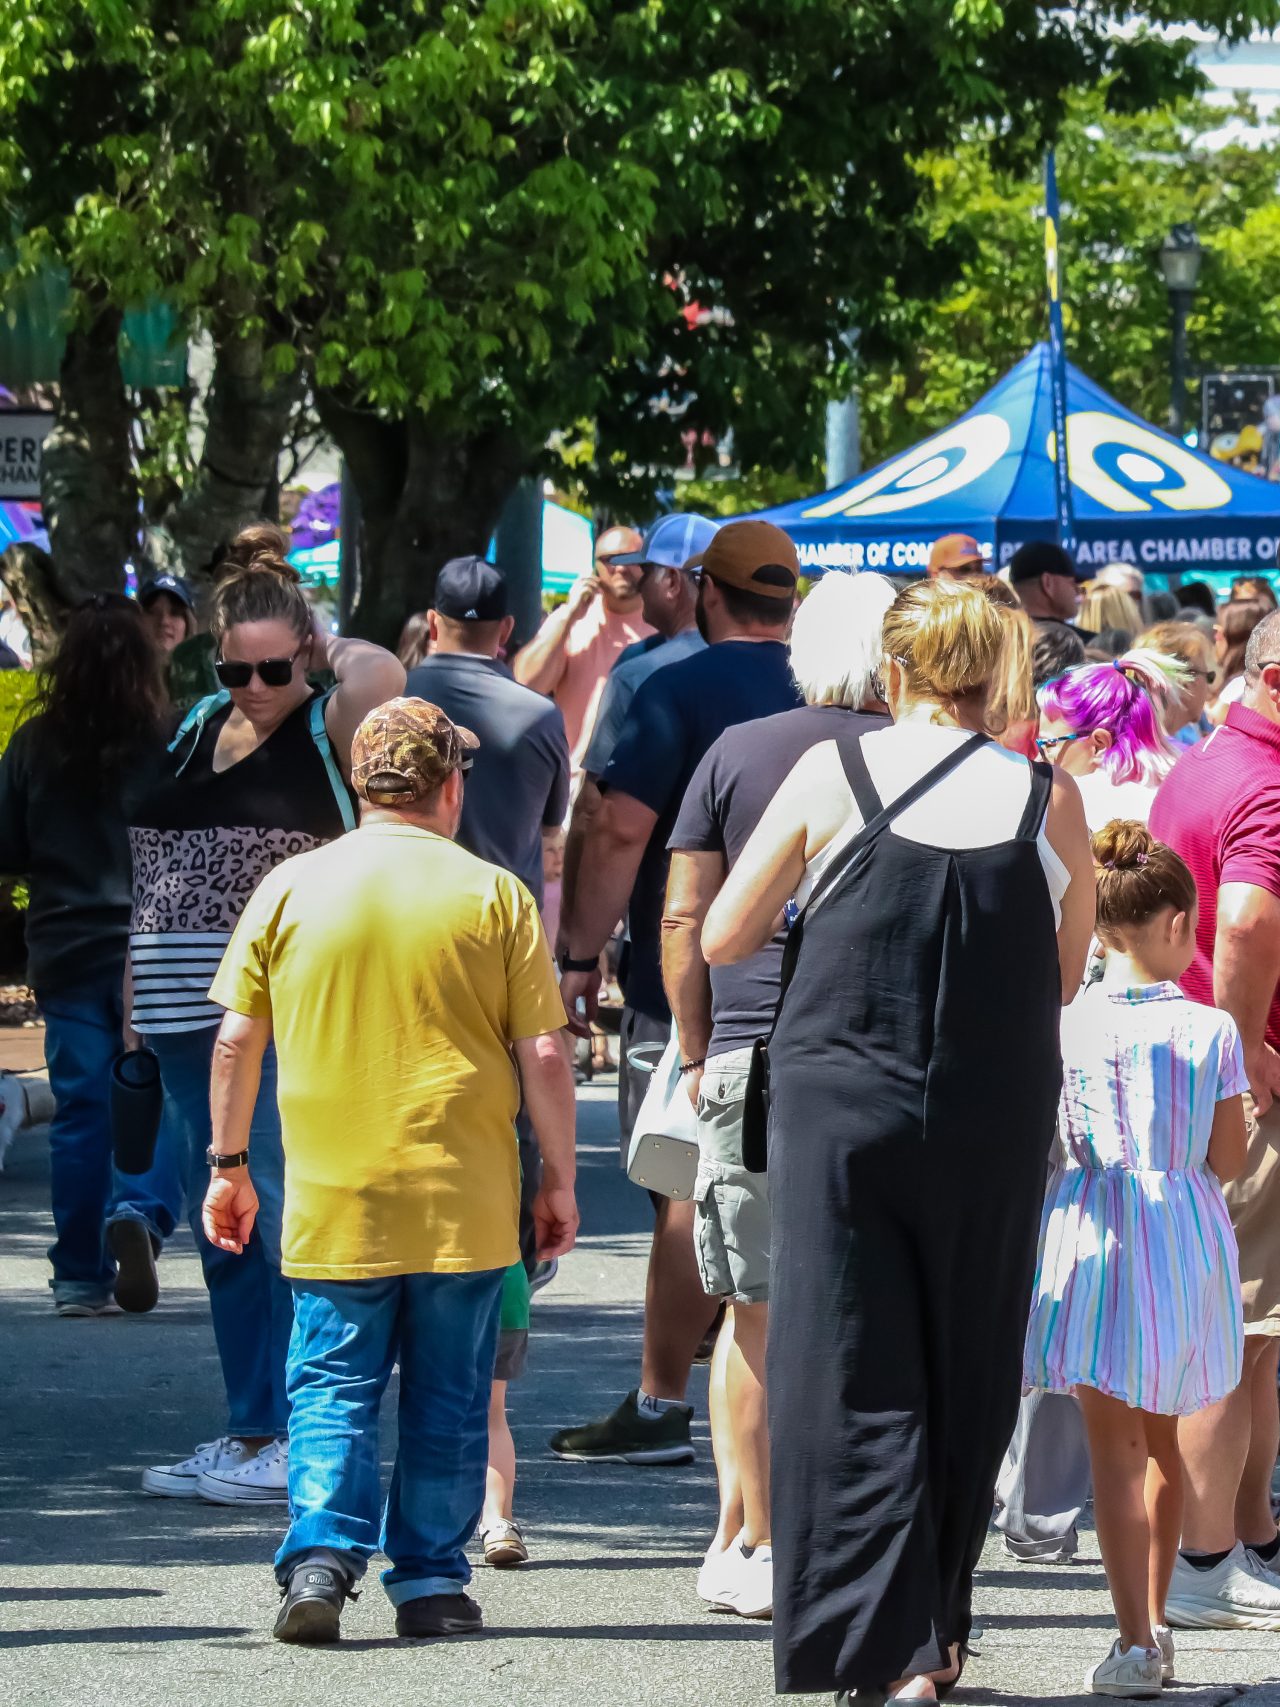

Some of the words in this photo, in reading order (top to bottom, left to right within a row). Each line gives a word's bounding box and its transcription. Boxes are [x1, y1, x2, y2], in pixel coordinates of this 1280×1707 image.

[794, 543, 864, 566] HAMBER
[867, 542, 891, 566] OF
[1076, 540, 1136, 564] AREA
[1140, 537, 1251, 562] CHAMBER
